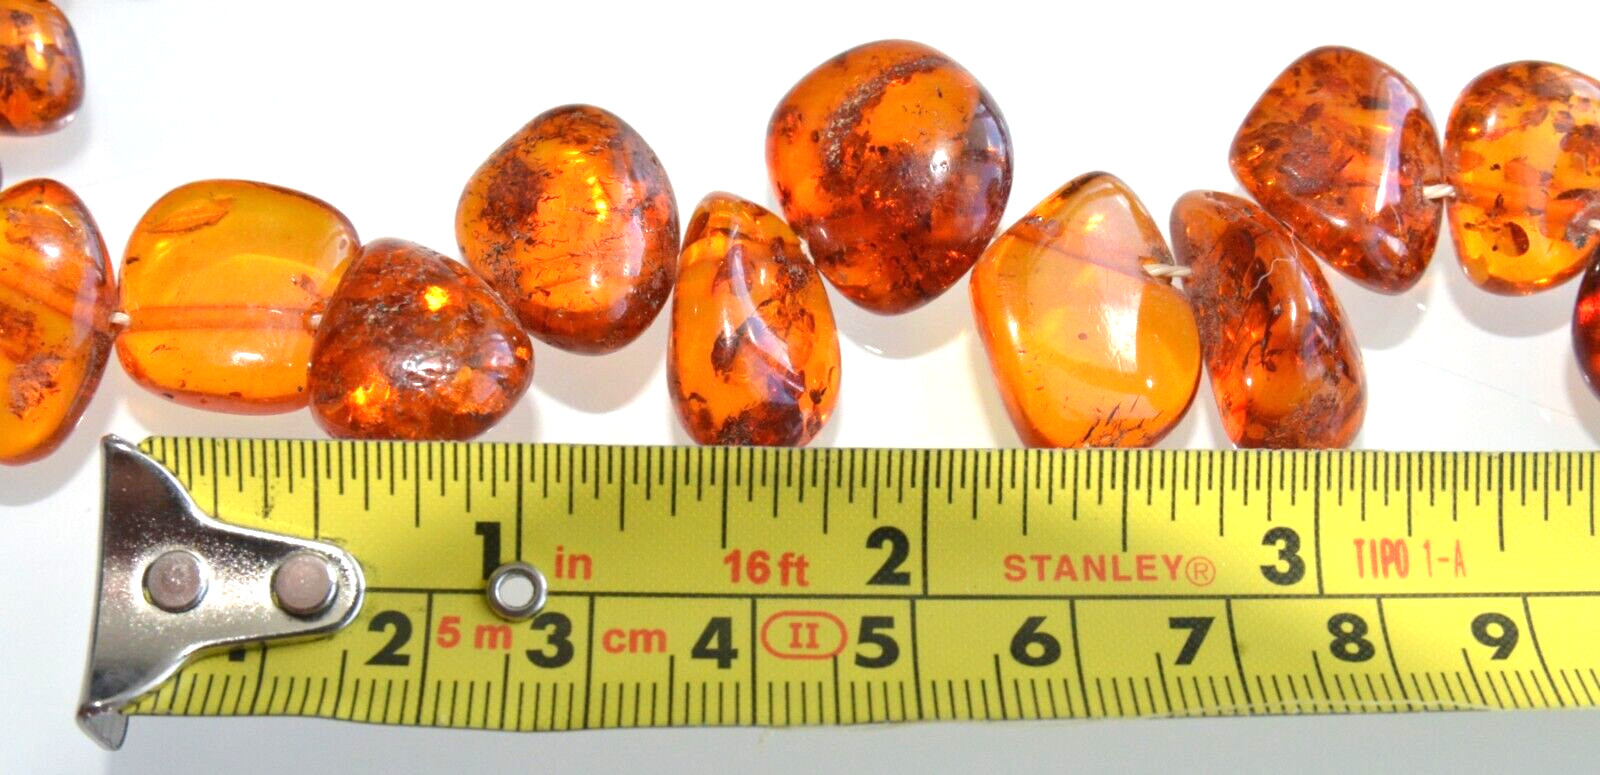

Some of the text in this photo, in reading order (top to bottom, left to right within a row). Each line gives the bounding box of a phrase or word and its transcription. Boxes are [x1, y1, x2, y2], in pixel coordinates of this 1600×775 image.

[555, 545, 592, 580] in
[723, 549, 809, 587] 16 ft
[865, 525, 911, 586] 2
[1260, 526, 1306, 586] 3
[1353, 537, 1410, 579] TIPO
[365, 610, 412, 666] 2
[436, 616, 513, 650] 5 m
[526, 612, 574, 669] 3
[602, 627, 667, 654] cm
[691, 616, 738, 669] 4
[854, 616, 900, 668] 5
[1010, 616, 1061, 667] 6
[1168, 616, 1216, 665] 7
[1327, 612, 1375, 662] 8
[1471, 612, 1519, 660] 9
